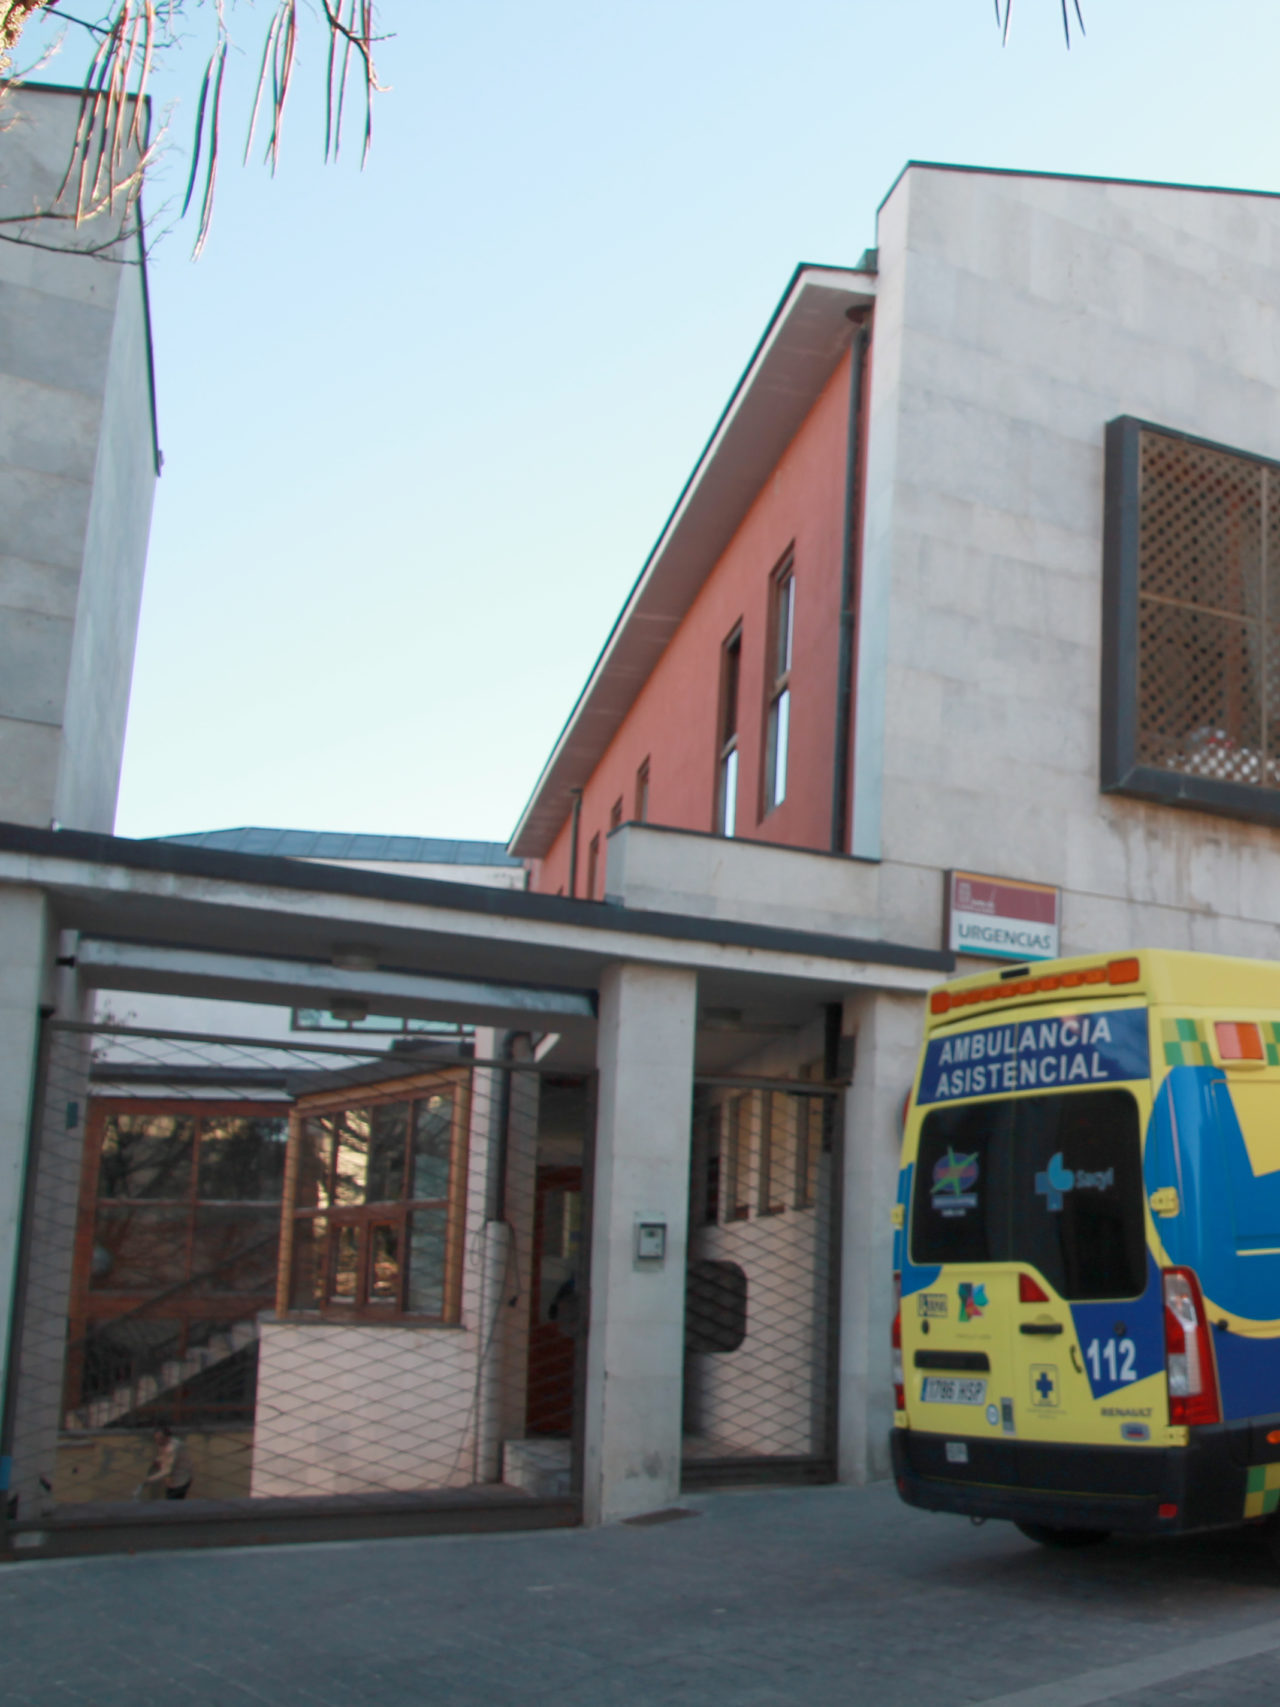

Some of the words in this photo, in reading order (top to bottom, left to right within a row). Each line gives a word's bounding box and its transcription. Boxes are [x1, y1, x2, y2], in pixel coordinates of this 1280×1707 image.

[958, 923, 1051, 949] URGENCIAS
[938, 1016, 1112, 1067] AMBULANCIA
[935, 1052, 1108, 1097] ASISTENCIAL
[1087, 1338, 1138, 1381] 112
[1101, 1407, 1152, 1417] RENAULT
